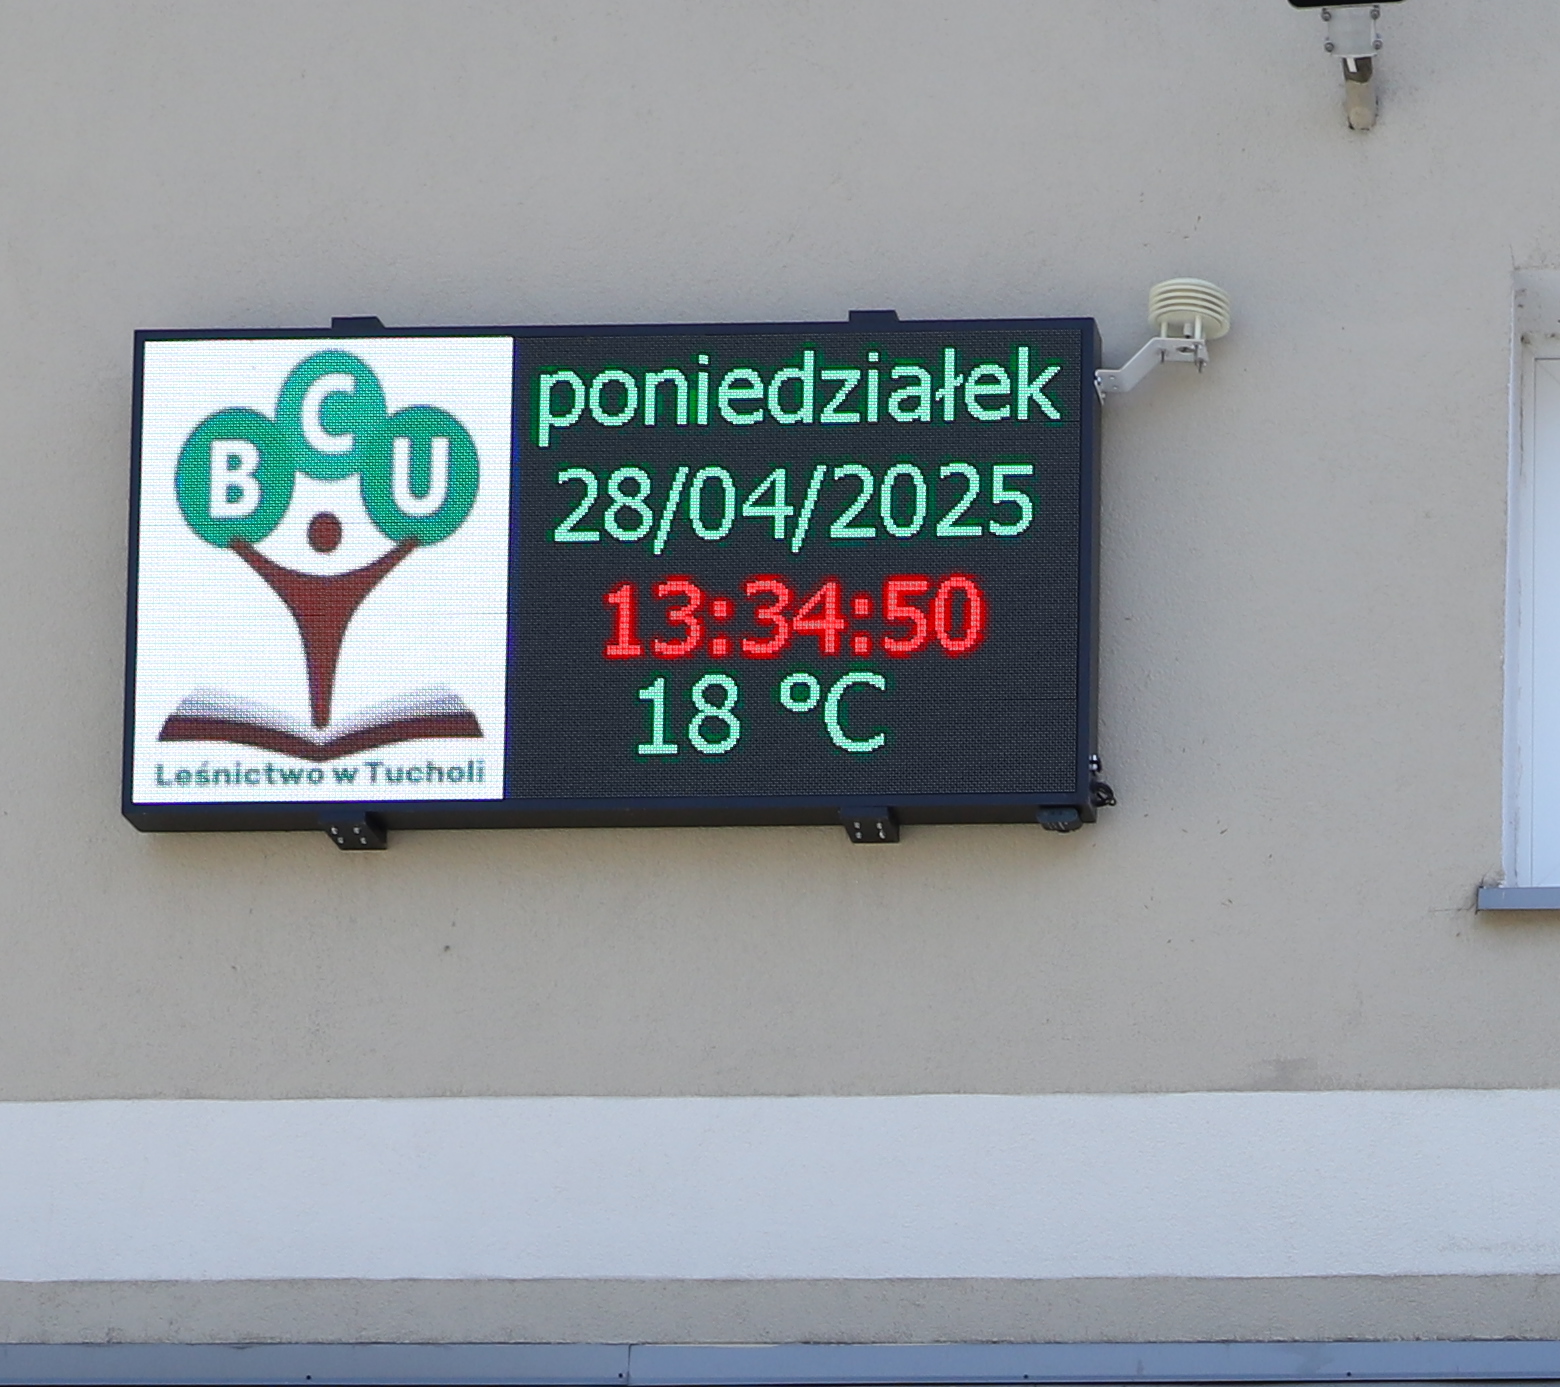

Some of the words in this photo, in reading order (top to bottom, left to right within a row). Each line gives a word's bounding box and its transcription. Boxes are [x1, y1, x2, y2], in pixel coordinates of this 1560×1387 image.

[539, 347, 1060, 447] poniedziałek
[555, 463, 1033, 554] 28/04/2025
[607, 577, 981, 657] 13:34:50
[638, 675, 740, 754] 18
[780, 672, 885, 751] °C
[155, 761, 325, 786] Leśnictwo
[333, 767, 358, 785] w
[363, 760, 485, 784] Tucholi
